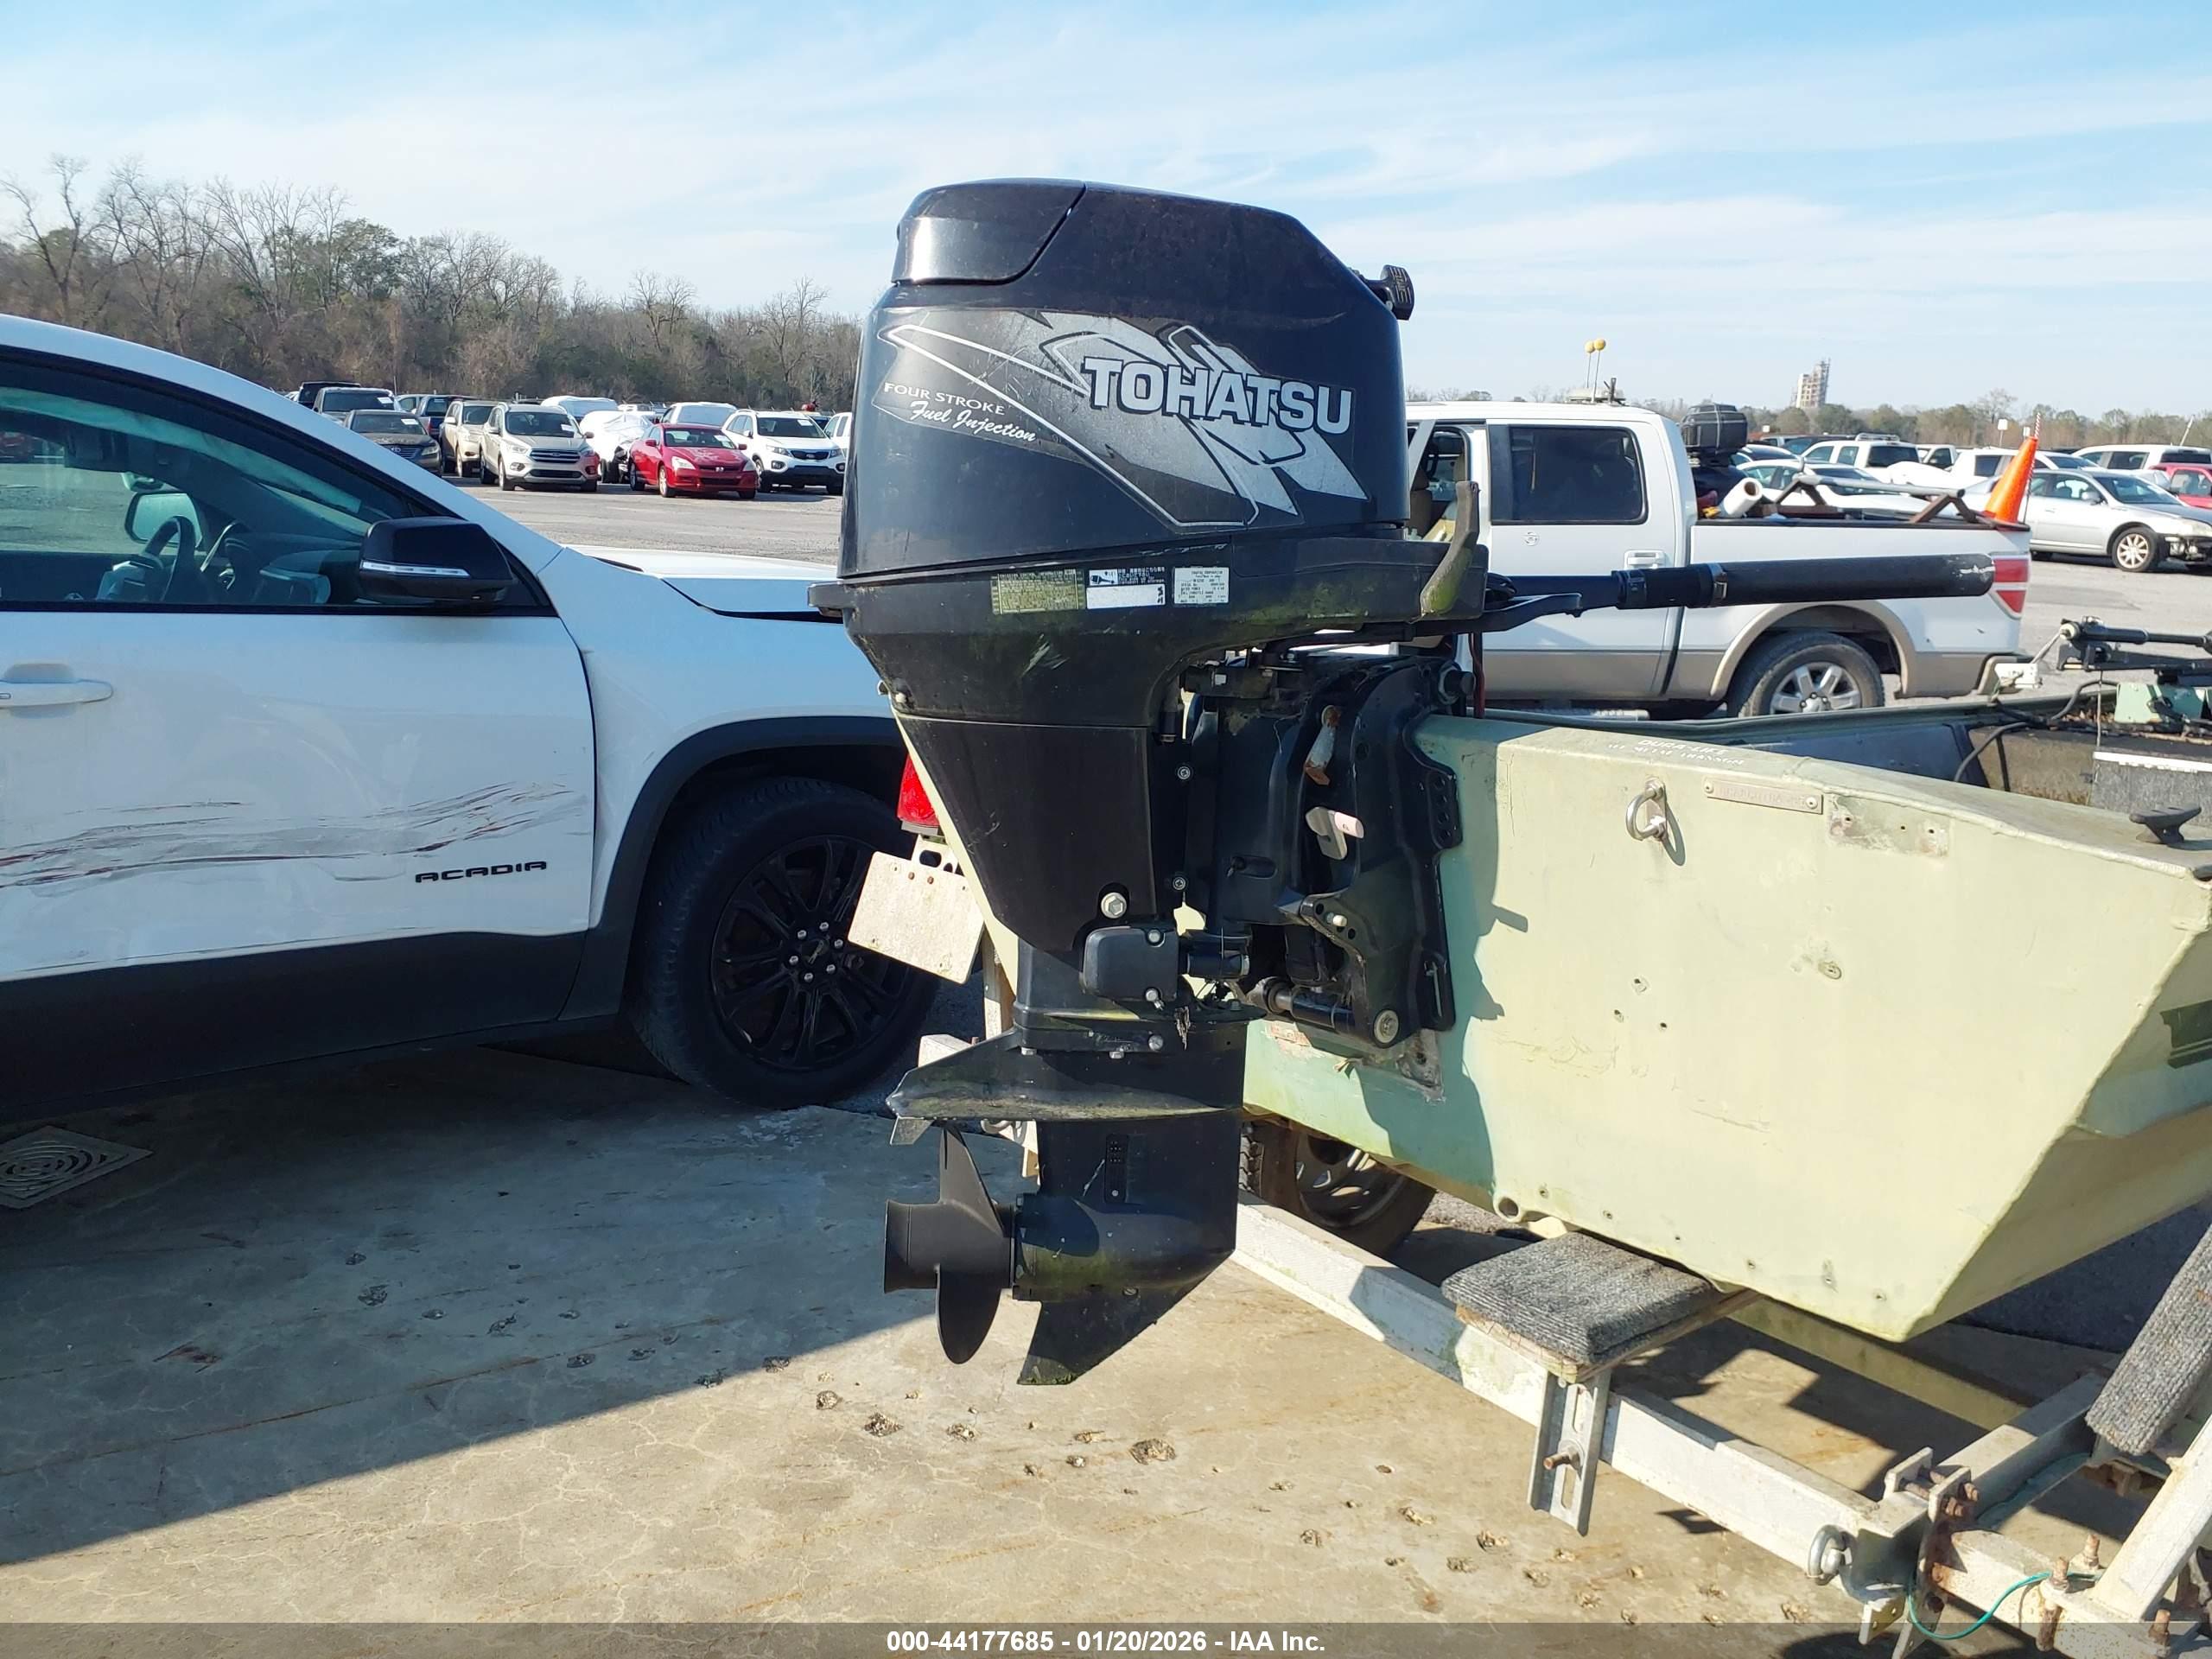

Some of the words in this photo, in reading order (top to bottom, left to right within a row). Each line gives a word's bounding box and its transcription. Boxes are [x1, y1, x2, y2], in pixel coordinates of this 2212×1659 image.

[883, 382, 930, 400] FOUR
[935, 392, 1005, 416] STROKE
[1084, 357, 1351, 434] TOHATSU
[910, 400, 952, 421] Fuel
[952, 409, 1037, 442] Injection
[415, 861, 547, 883] ACADIA
